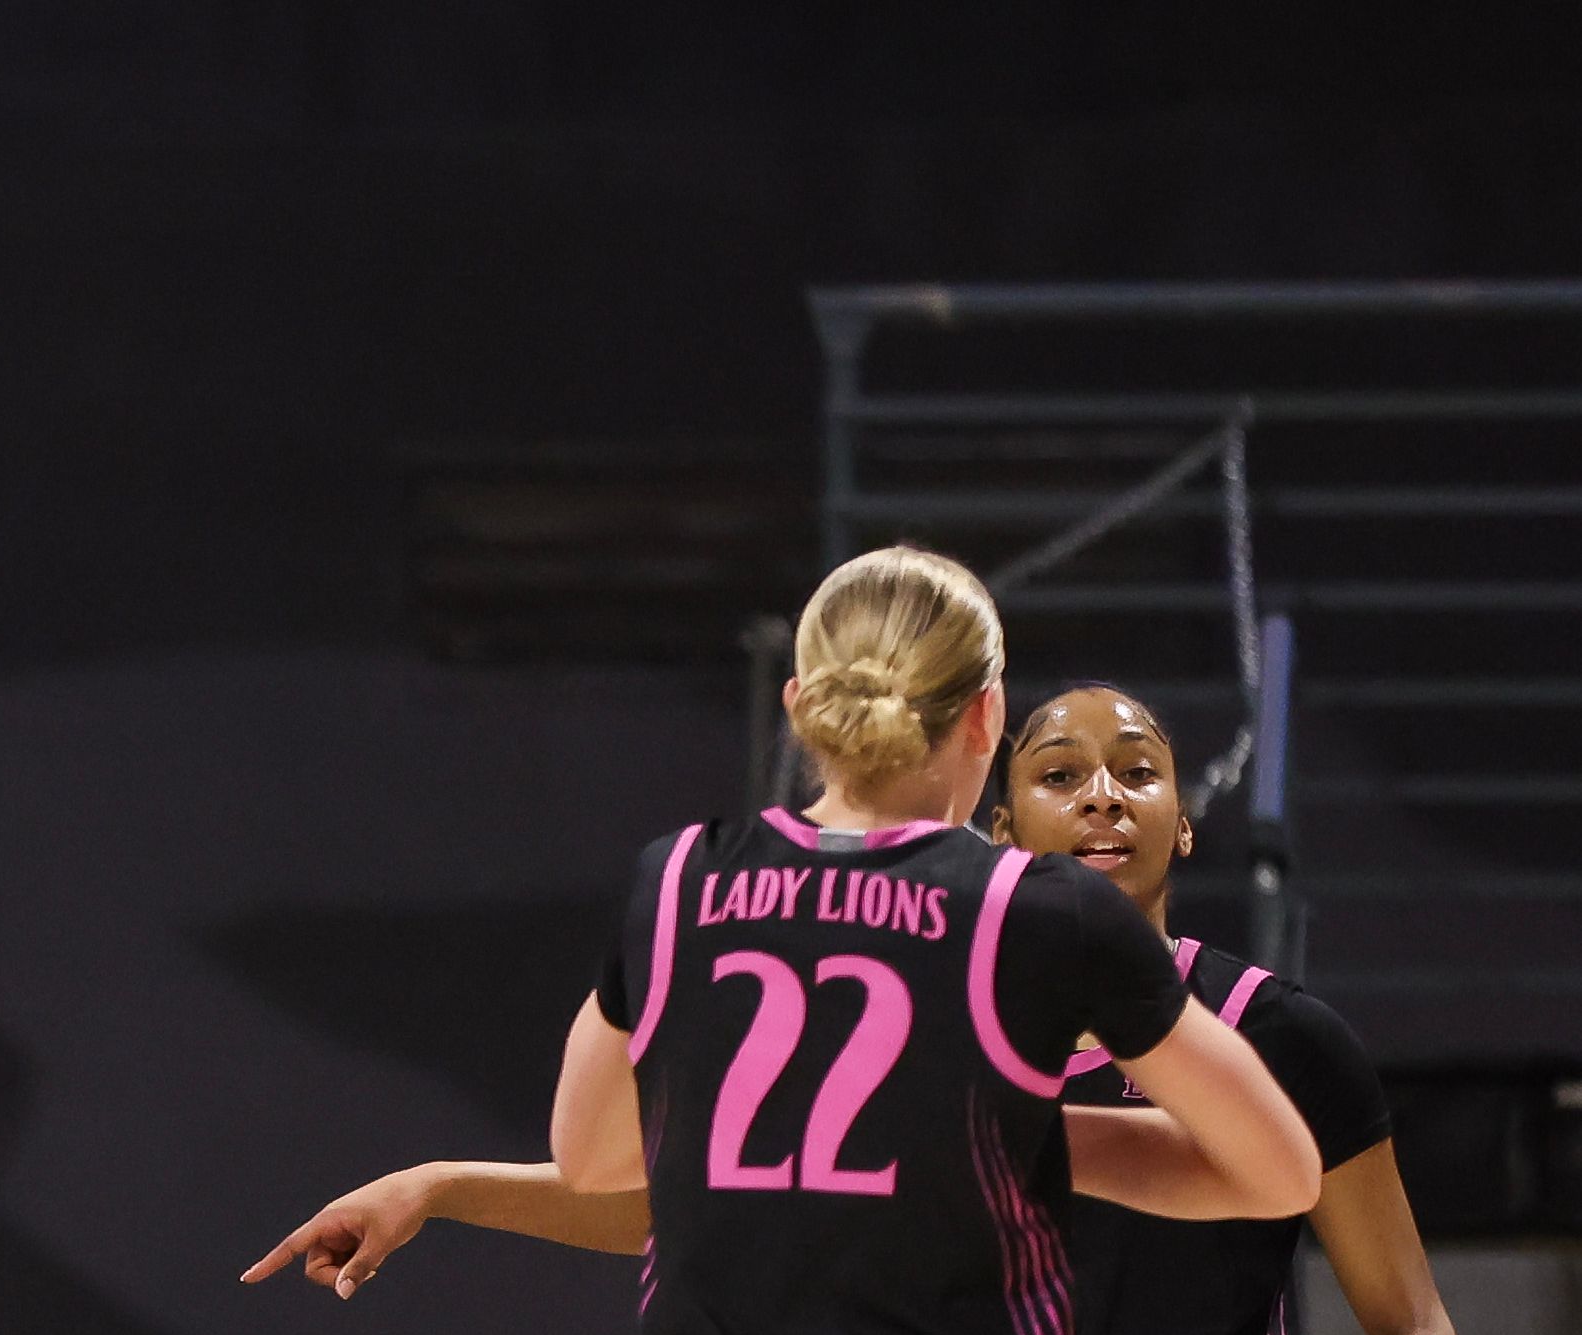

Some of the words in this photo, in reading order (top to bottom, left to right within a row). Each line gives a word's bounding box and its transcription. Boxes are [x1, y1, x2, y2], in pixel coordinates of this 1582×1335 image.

[697, 866, 811, 928] LADY
[816, 866, 950, 942] LIONS
[706, 949, 915, 1197] 22
